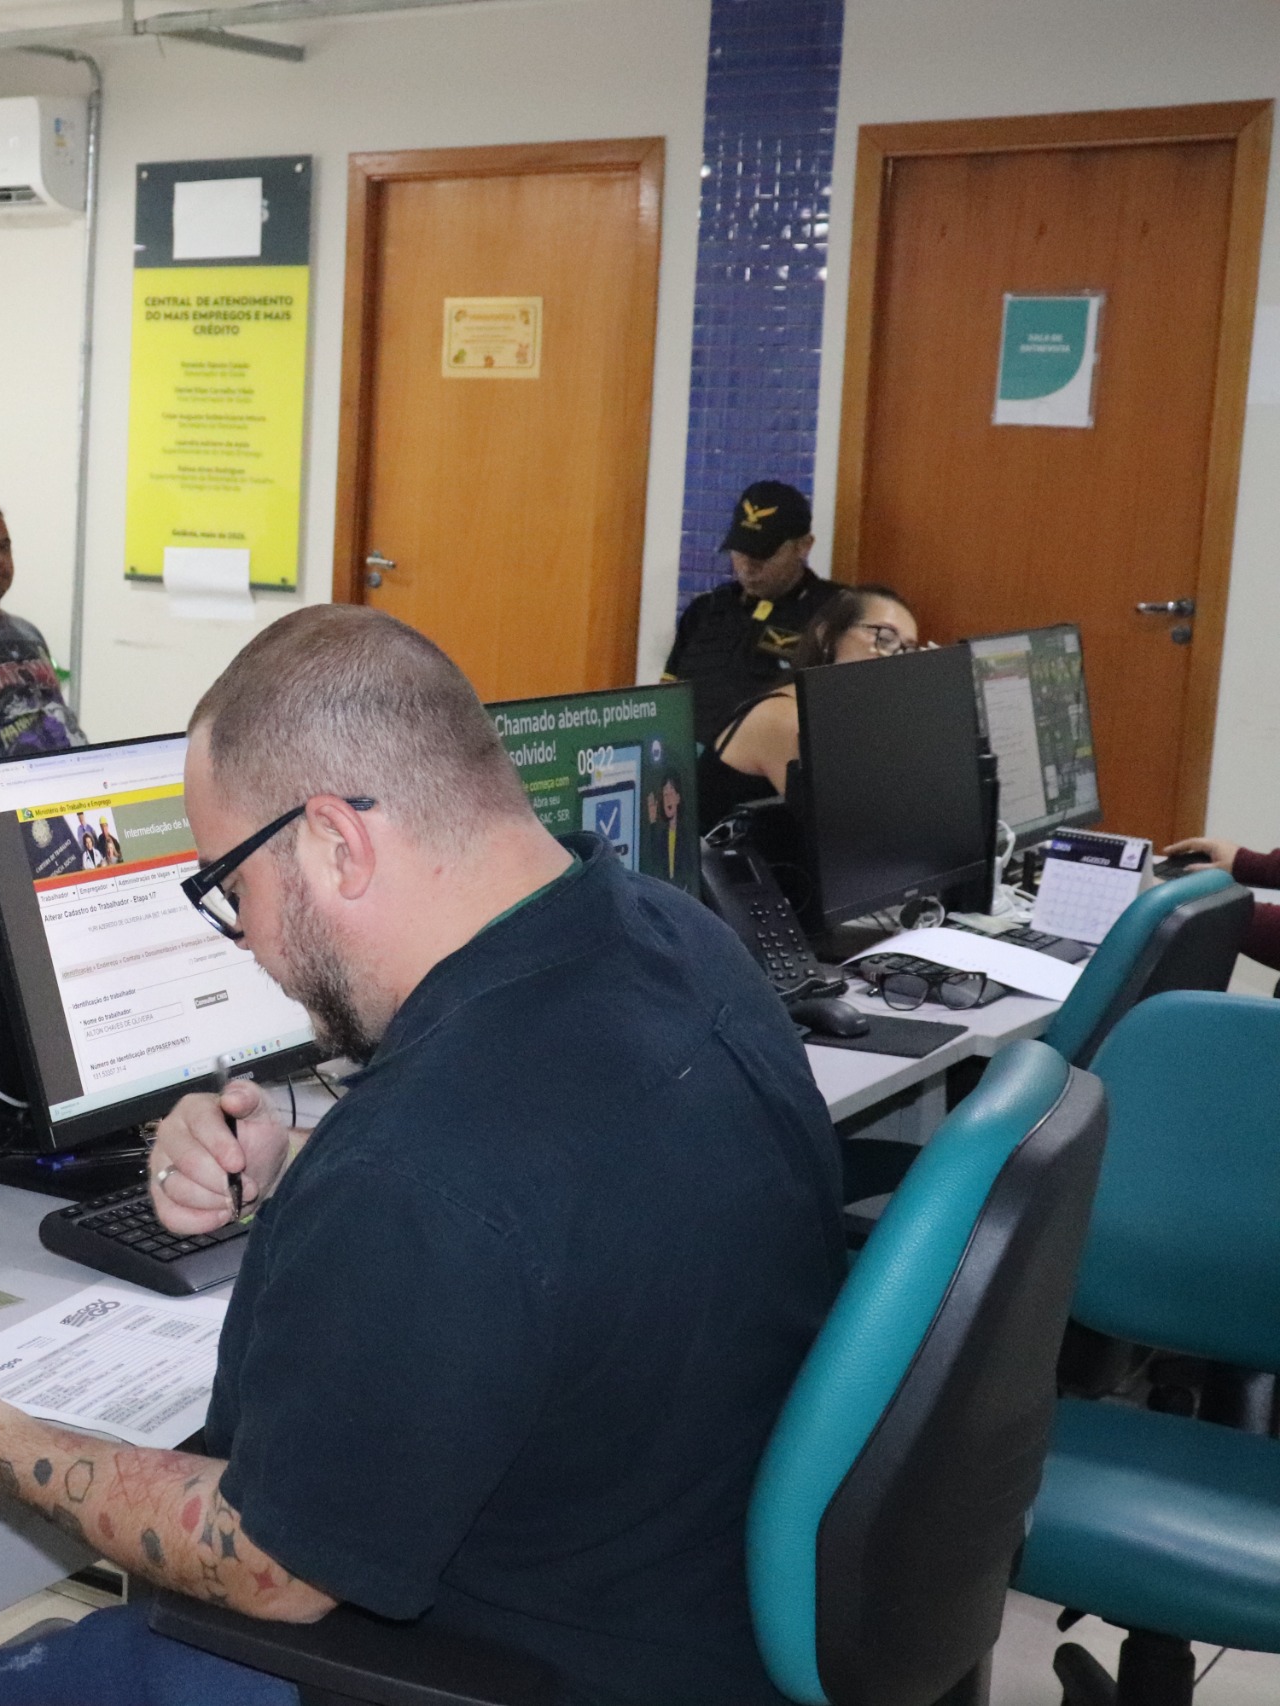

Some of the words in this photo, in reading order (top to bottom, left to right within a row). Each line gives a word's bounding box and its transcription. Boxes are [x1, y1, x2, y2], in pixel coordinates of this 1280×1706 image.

[145, 296, 192, 307] CENTRAL
[196, 296, 209, 306] DE
[212, 296, 293, 307] ATENDIMENTO
[145, 310, 161, 321] DO
[163, 310, 189, 321] MAIS
[192, 310, 251, 321] EMPREGOS
[263, 311, 291, 321] MAIS
[193, 322, 240, 335] CRÉDITO
[495, 708, 555, 737] Chamado
[558, 706, 601, 730] aberto,
[603, 699, 657, 728] problema
[509, 740, 557, 767] solvido!
[578, 745, 614, 776] 08:22
[556, 776, 570, 787] com
[35, 806, 59, 816] Ministério
[59, 805, 67, 813] do
[66, 801, 86, 811] Trabalho
[90, 798, 111, 808] Emprego
[124, 820, 173, 839] Intermediação
[173, 818, 182, 829] de
[40, 890, 69, 902] Trabalhador
[79, 883, 108, 895] Empregador
[118, 874, 151, 886] Administração
[44, 910, 63, 922] Alterar
[64, 906, 89, 919] Cadastro
[89, 905, 97, 913] do
[97, 897, 129, 911] Trabalhador
[133, 894, 148, 905] Etapa
[72, 995, 103, 1010] Identificação
[110, 988, 136, 1000] trabalhador
[83, 1016, 97, 1026] Nome
[98, 1014, 105, 1022] do
[124, 1019, 131, 1027] DE
